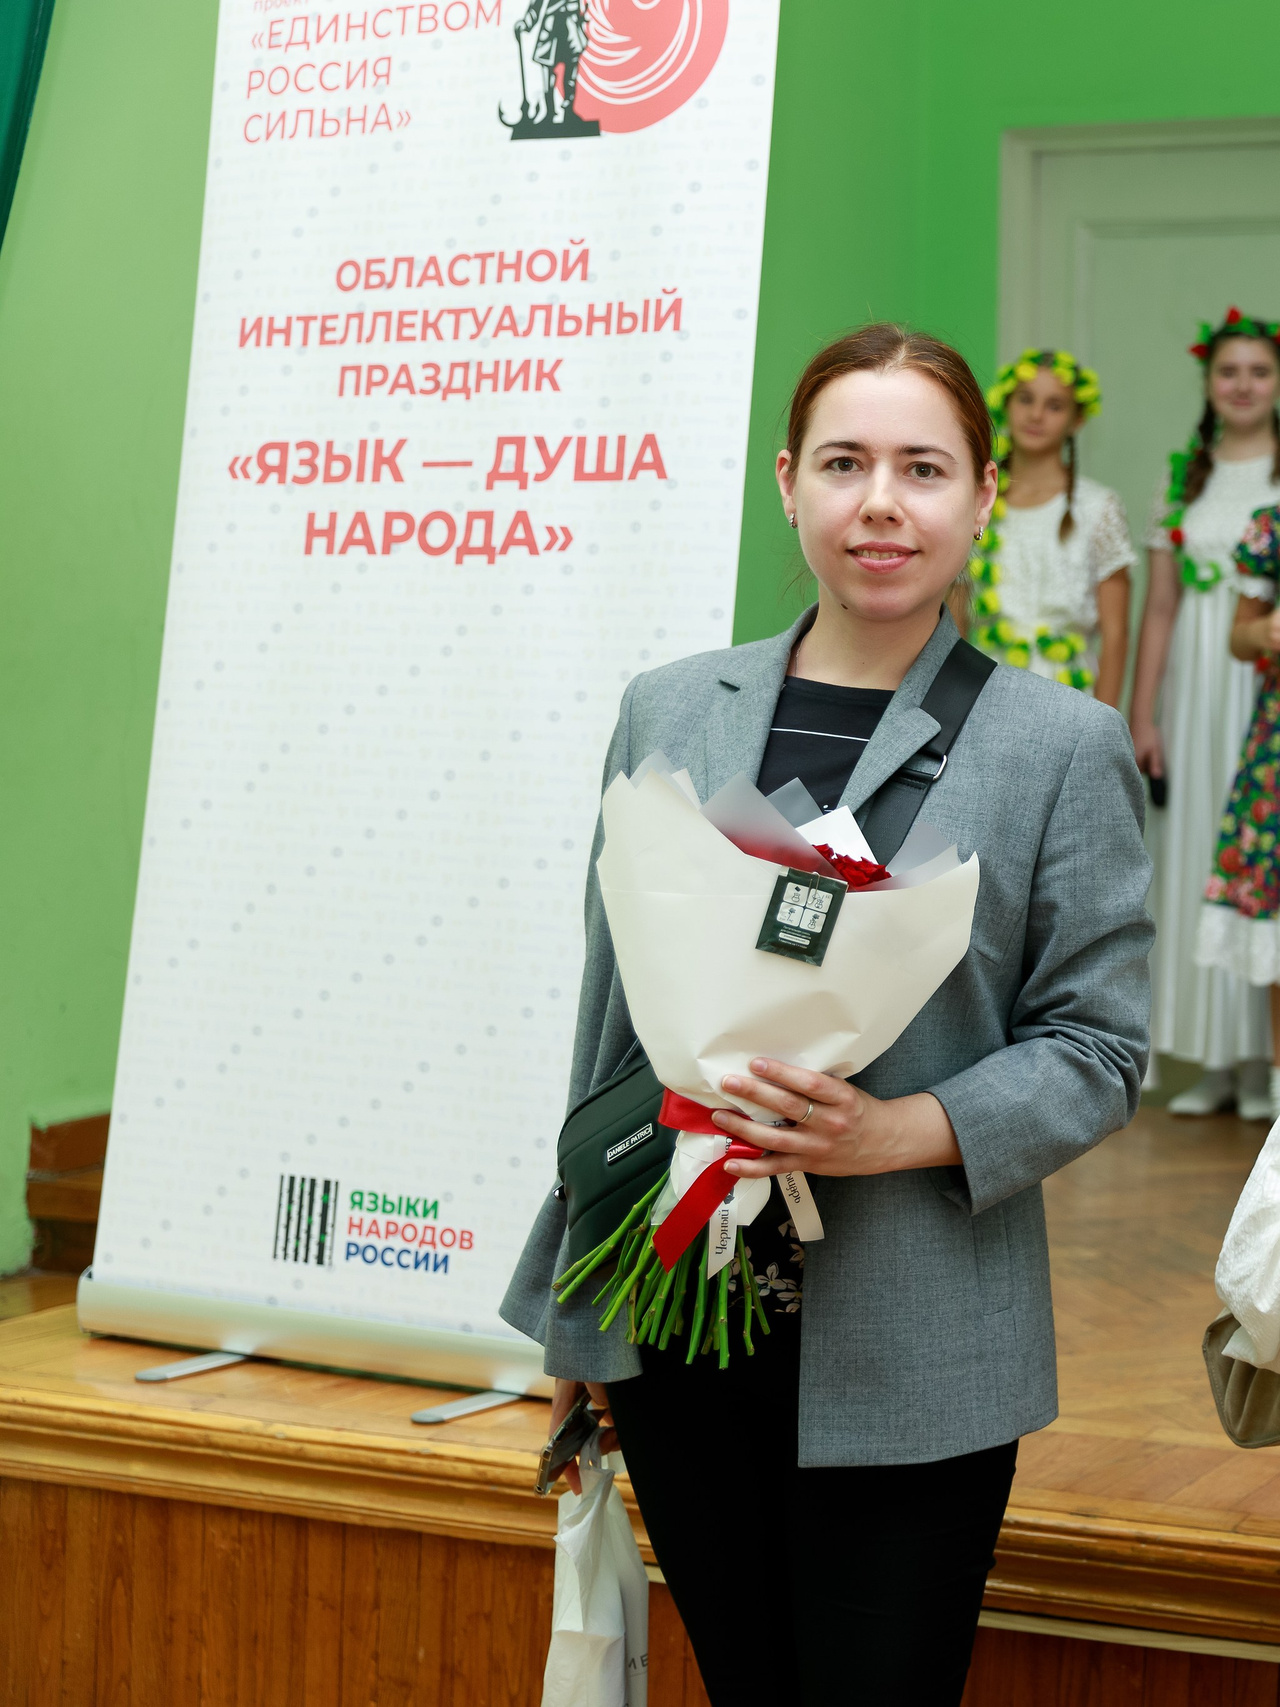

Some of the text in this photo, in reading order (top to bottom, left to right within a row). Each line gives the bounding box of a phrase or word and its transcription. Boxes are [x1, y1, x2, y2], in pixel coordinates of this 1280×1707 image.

[251, 0, 502, 52] «ЕДИНСТВОМ
[246, 56, 392, 99] РОССИЯ
[243, 103, 412, 143] СИЛЬНА»
[336, 239, 590, 292] ОБЛАСТНОЙ
[238, 287, 683, 348] ИНТЕЛЛЕКТУАЛЬНЫЙ
[337, 358, 564, 400] ПРАЗДНИК
[228, 438, 408, 486] «ЯЗЫК
[485, 434, 668, 490] ДУША
[303, 509, 574, 565] НАРОДА»
[349, 1190, 439, 1220] ЯЗЫКИ
[347, 1216, 474, 1250] НАРОДОВ
[715, 1209, 731, 1255] Черный
[345, 1242, 449, 1274] РОССИИ
